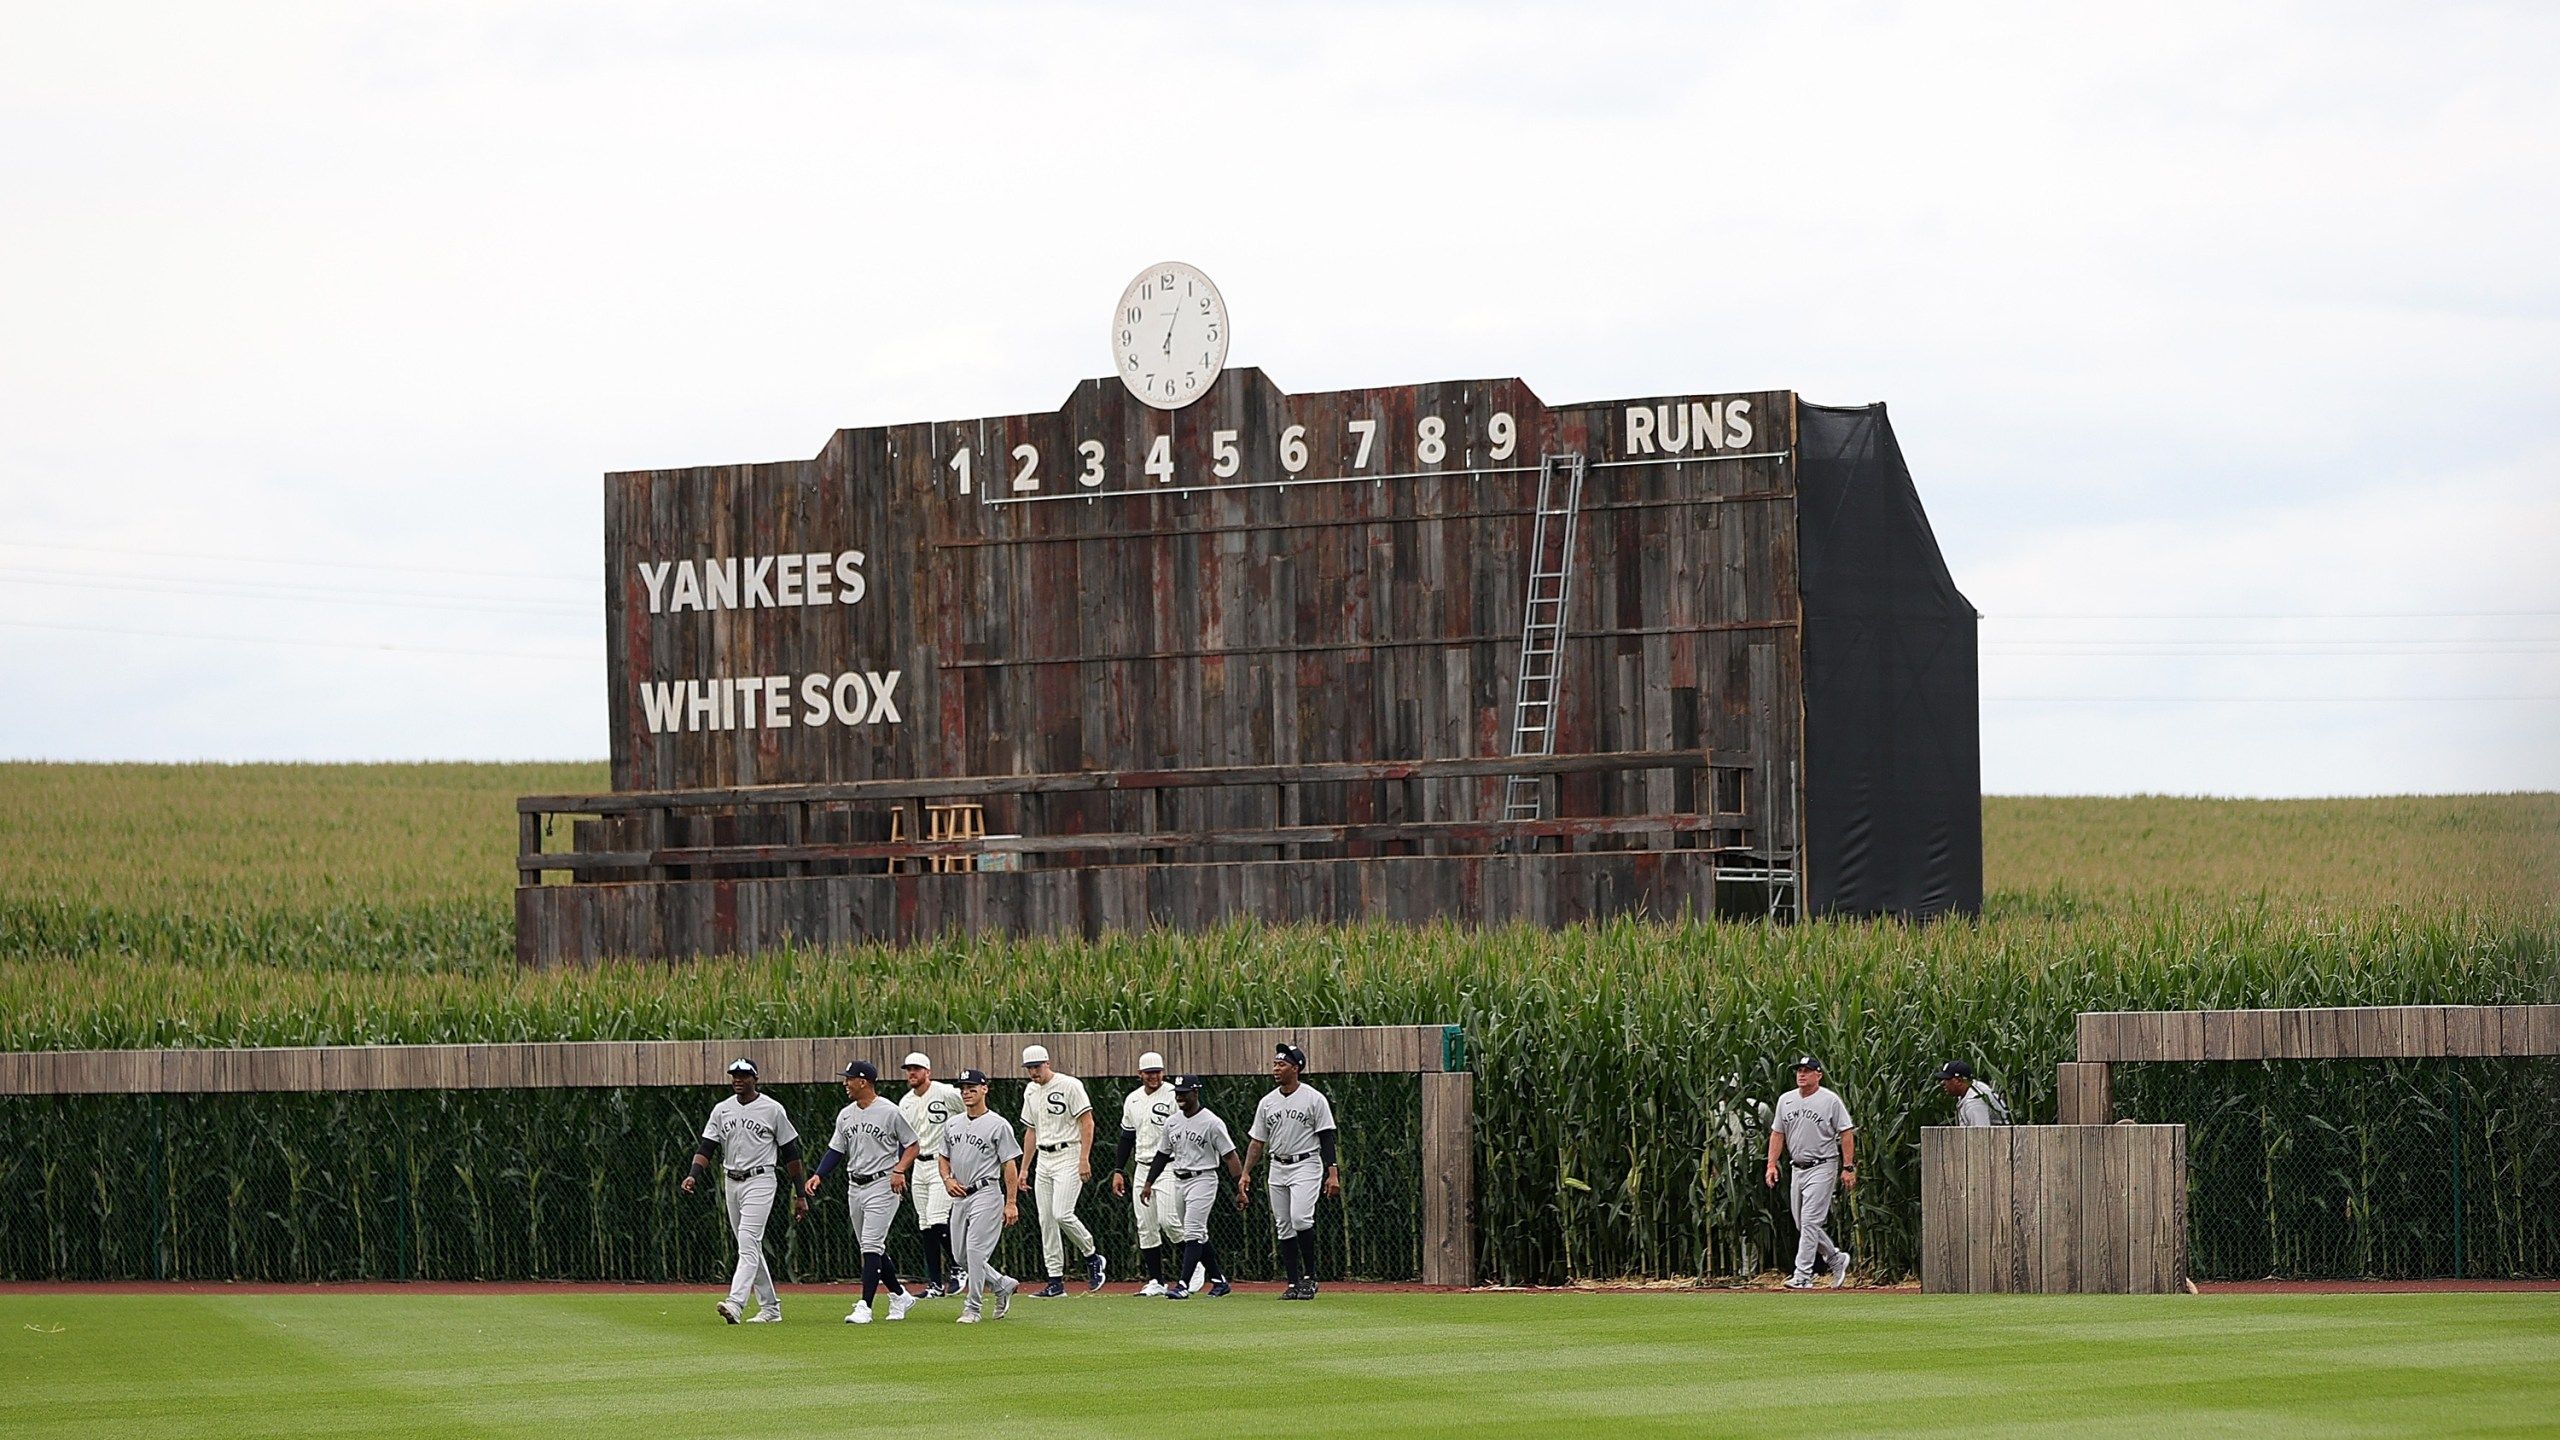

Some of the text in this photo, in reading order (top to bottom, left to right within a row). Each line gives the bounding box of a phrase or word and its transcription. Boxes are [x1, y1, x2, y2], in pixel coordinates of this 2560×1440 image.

[1161, 273, 1175, 291] 12
[1142, 284, 1152, 300] 11
[1127, 306, 1142, 324] 10
[1200, 298, 1211, 315] 2
[1122, 329, 1132, 347] 9
[1128, 354, 1139, 371] 8
[1199, 352, 1211, 369] 4
[1146, 374, 1155, 391] 7
[1165, 380, 1175, 397] 6
[1185, 371, 1196, 389] 5
[949, 400, 1752, 495] 1 2 3 4 5 6 7 8 9 RUNS
[638, 550, 866, 614] YANKEES
[640, 670, 902, 734] WHITE SOX
[1266, 1109, 1310, 1128] NEW YORK
[1801, 1108, 1824, 1126] YORK
[741, 1118, 767, 1138] YORK
[861, 1122, 887, 1142] YORK
[966, 1133, 990, 1154] YORK
[1186, 1130, 1208, 1149] YORK
